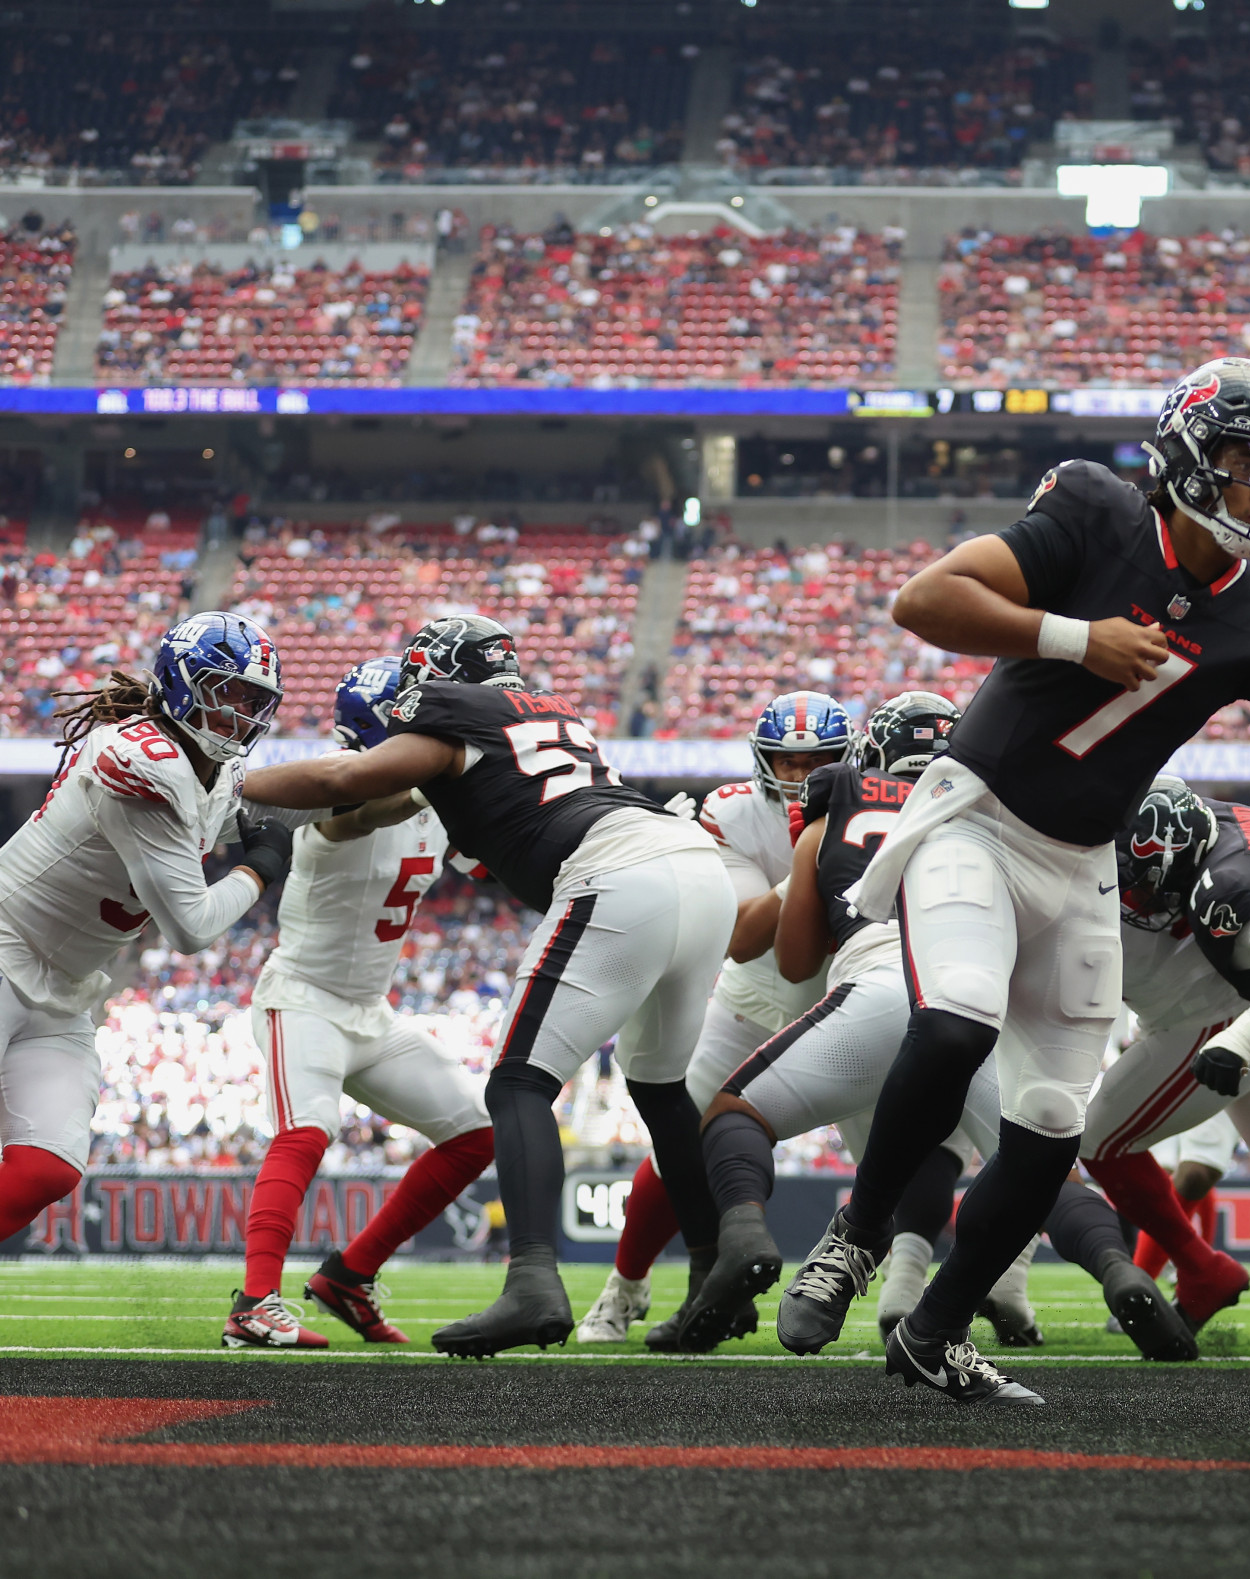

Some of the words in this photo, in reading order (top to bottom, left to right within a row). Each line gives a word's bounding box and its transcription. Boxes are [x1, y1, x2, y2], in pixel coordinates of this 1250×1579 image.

[1130, 603, 1203, 655] TEANS
[784, 715, 818, 732] 98
[1052, 647, 1199, 761] 7
[120, 722, 179, 761] 90
[861, 777, 914, 804] SCR
[374, 857, 435, 943] 5
